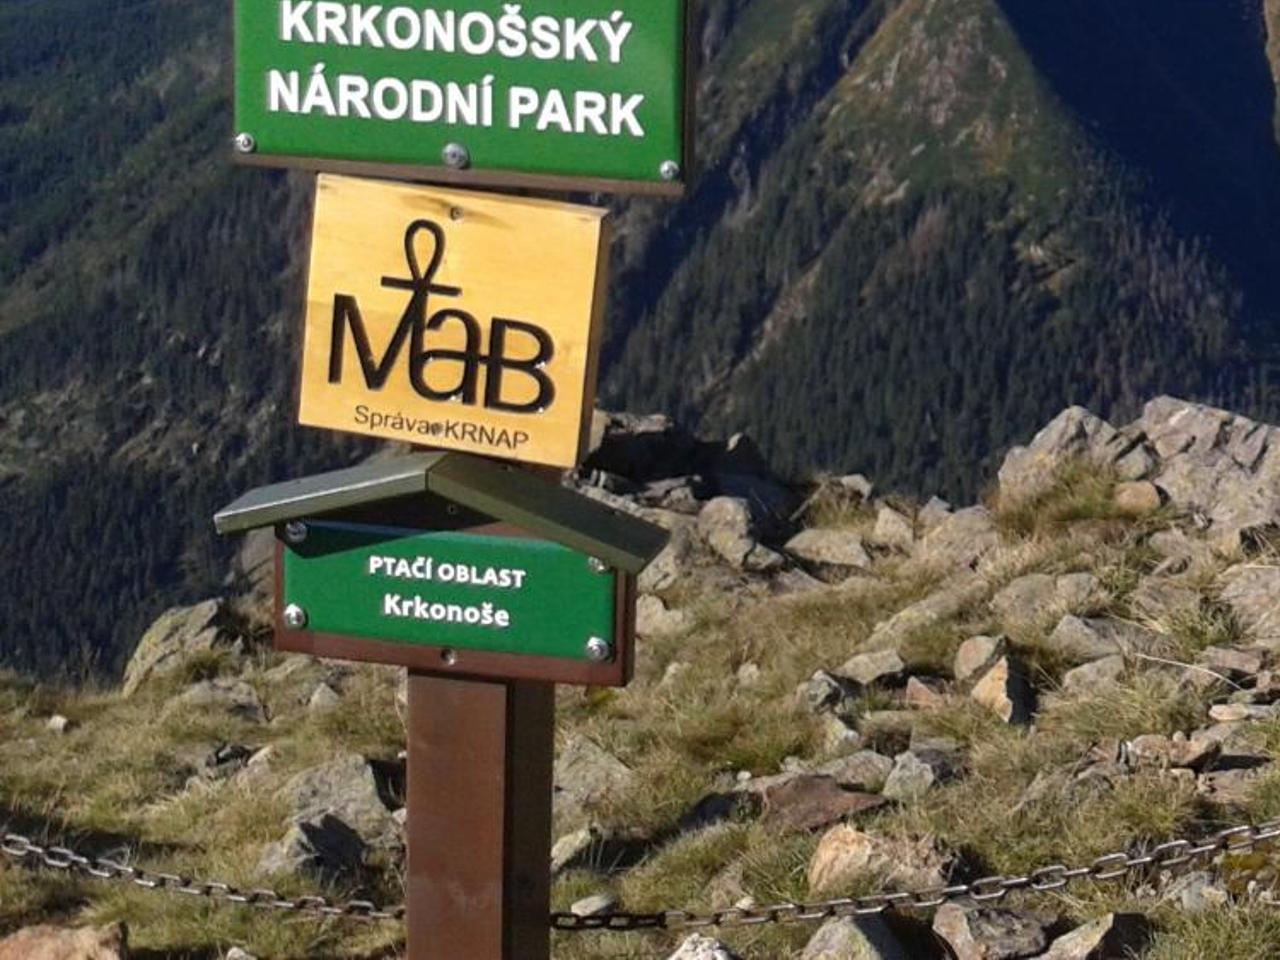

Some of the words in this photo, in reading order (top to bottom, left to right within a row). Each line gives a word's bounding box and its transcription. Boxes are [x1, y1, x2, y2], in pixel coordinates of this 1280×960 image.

[280, 0, 633, 63] KRKONOŠSKÝ
[268, 63, 495, 127] NÁRODNÍ
[508, 86, 645, 137] PARK
[354, 405, 430, 435] Správa
[445, 419, 529, 450] KRNAP
[369, 555, 433, 580] PTAČÍ
[438, 563, 526, 588] OBLAST
[384, 593, 510, 627] Krkonoše
